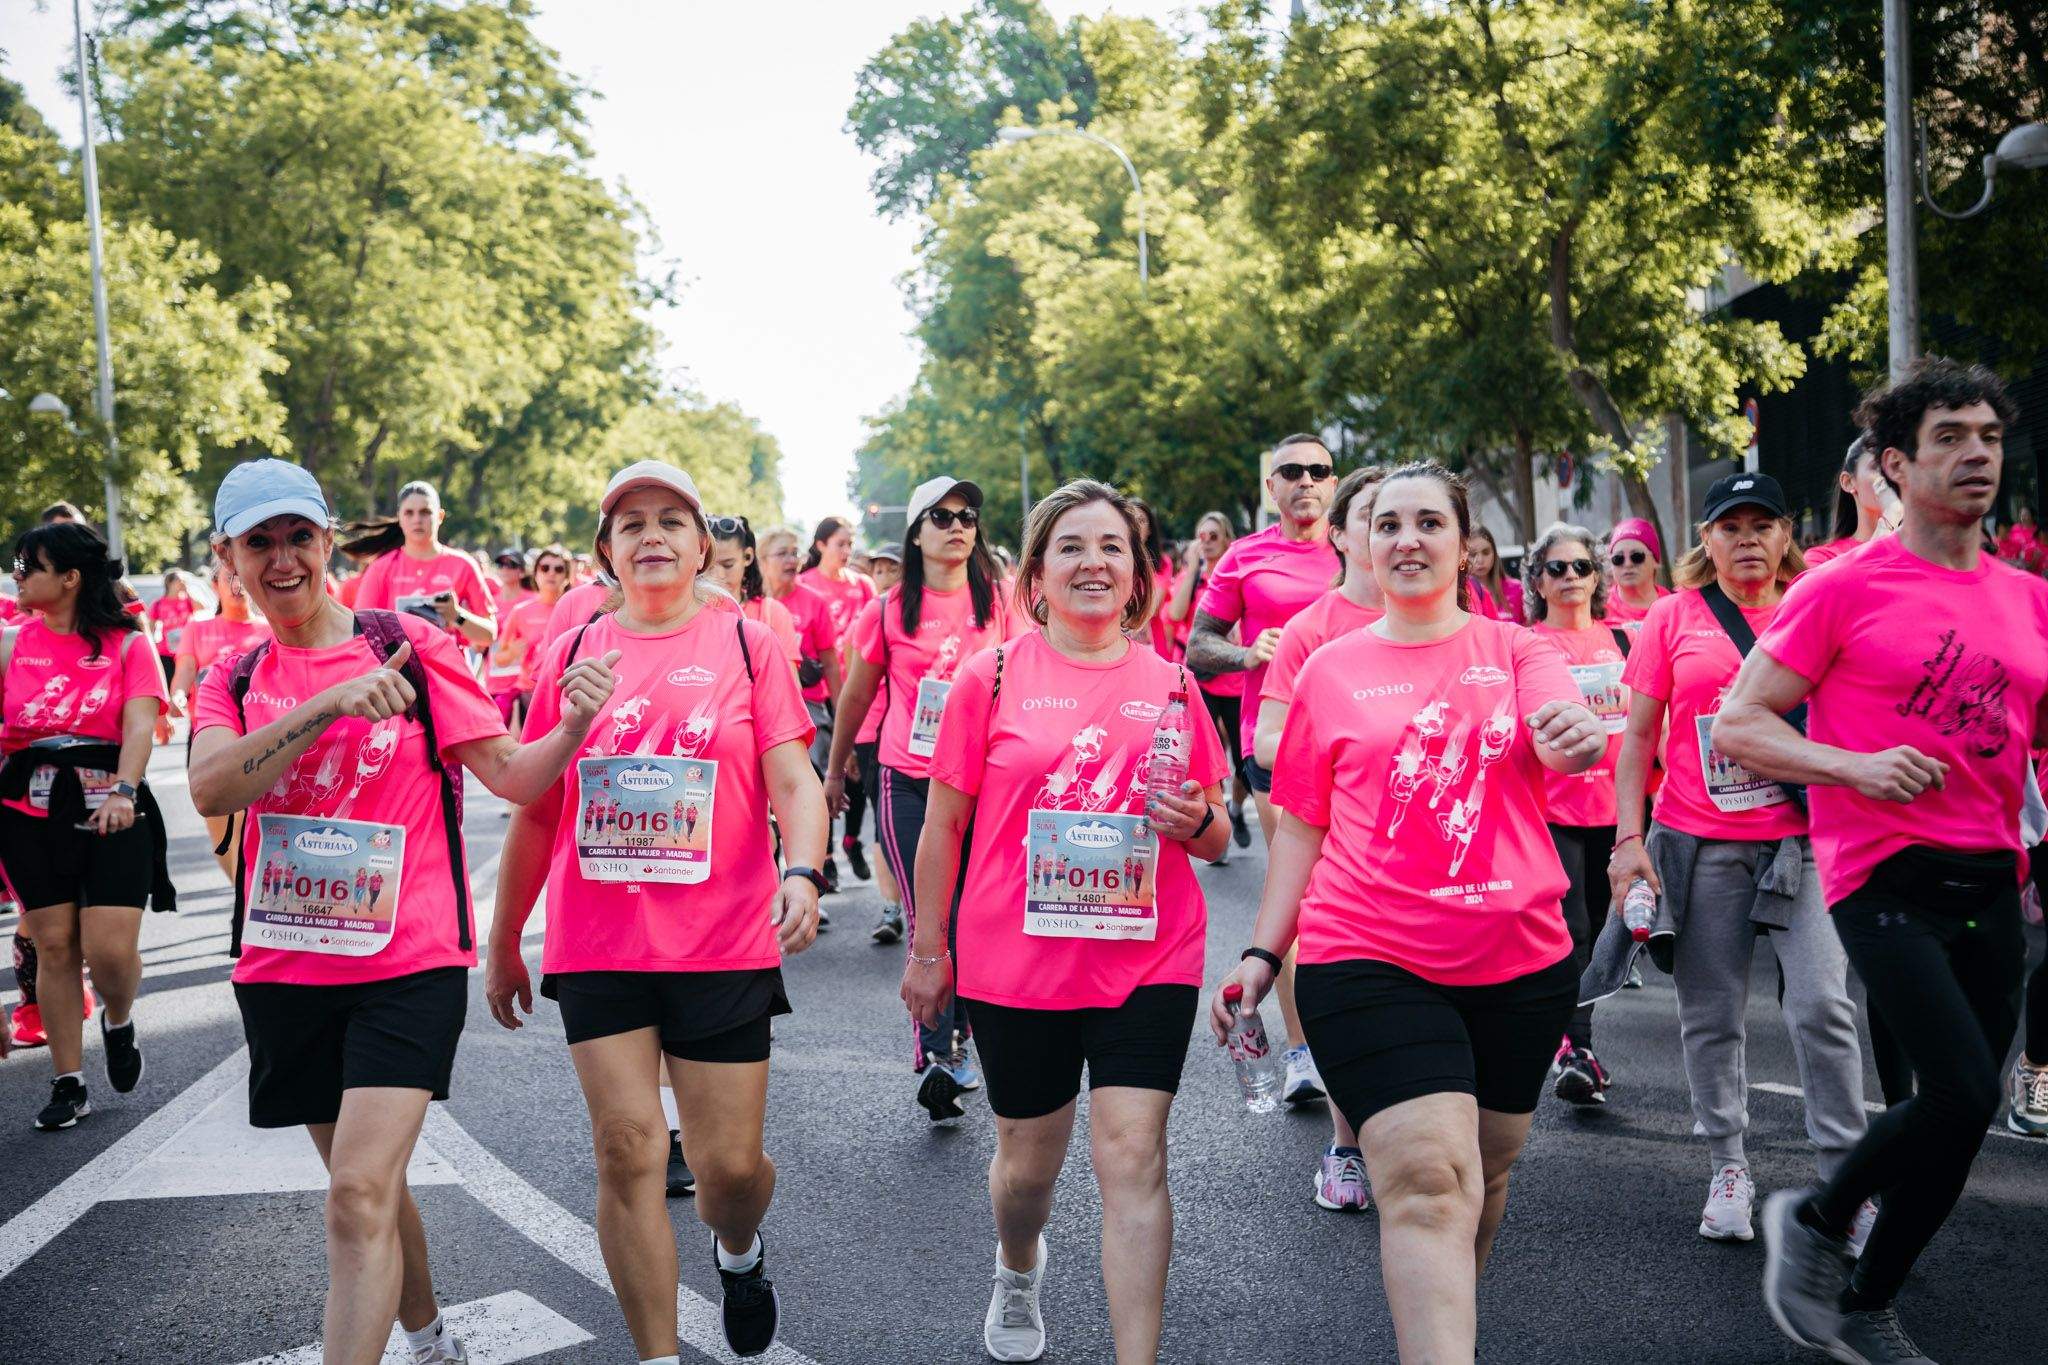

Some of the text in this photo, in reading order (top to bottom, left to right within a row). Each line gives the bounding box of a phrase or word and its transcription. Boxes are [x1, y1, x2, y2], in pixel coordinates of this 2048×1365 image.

[1353, 682, 1414, 700] OYSHO
[242, 691, 297, 710] OYSHO
[1022, 696, 1078, 711] OYSHO
[1585, 694, 1604, 706] 16
[620, 774, 670, 786] ASTURIANA
[1719, 785, 1744, 793] CARRERA
[1720, 795, 1755, 806] OYSHO
[618, 811, 668, 832] 016
[624, 837, 655, 846] 11987
[1070, 830, 1120, 843] ASTURIANA
[296, 837, 353, 852] ASTURIANA
[588, 848, 617, 856] CARRERA
[638, 849, 661, 857] MUJER
[666, 851, 693, 859] MADRID
[589, 863, 694, 876] OYSHO Santander
[1068, 867, 1120, 889] 016
[295, 876, 349, 900] 016
[1430, 880, 1513, 897] CARRERA DE LA MUJER
[1076, 894, 1106, 903] 14801
[1464, 894, 1484, 904] 2024
[302, 904, 333, 915] 16647
[1038, 903, 1142, 916] CARRERA DE LA MUJER MADRID
[265, 913, 375, 930] CARRERA DE LA MUJER MADRID
[1037, 918, 1143, 932] OYSHO Santander
[261, 928, 303, 944] OYSHO
[331, 937, 374, 948] Santander
